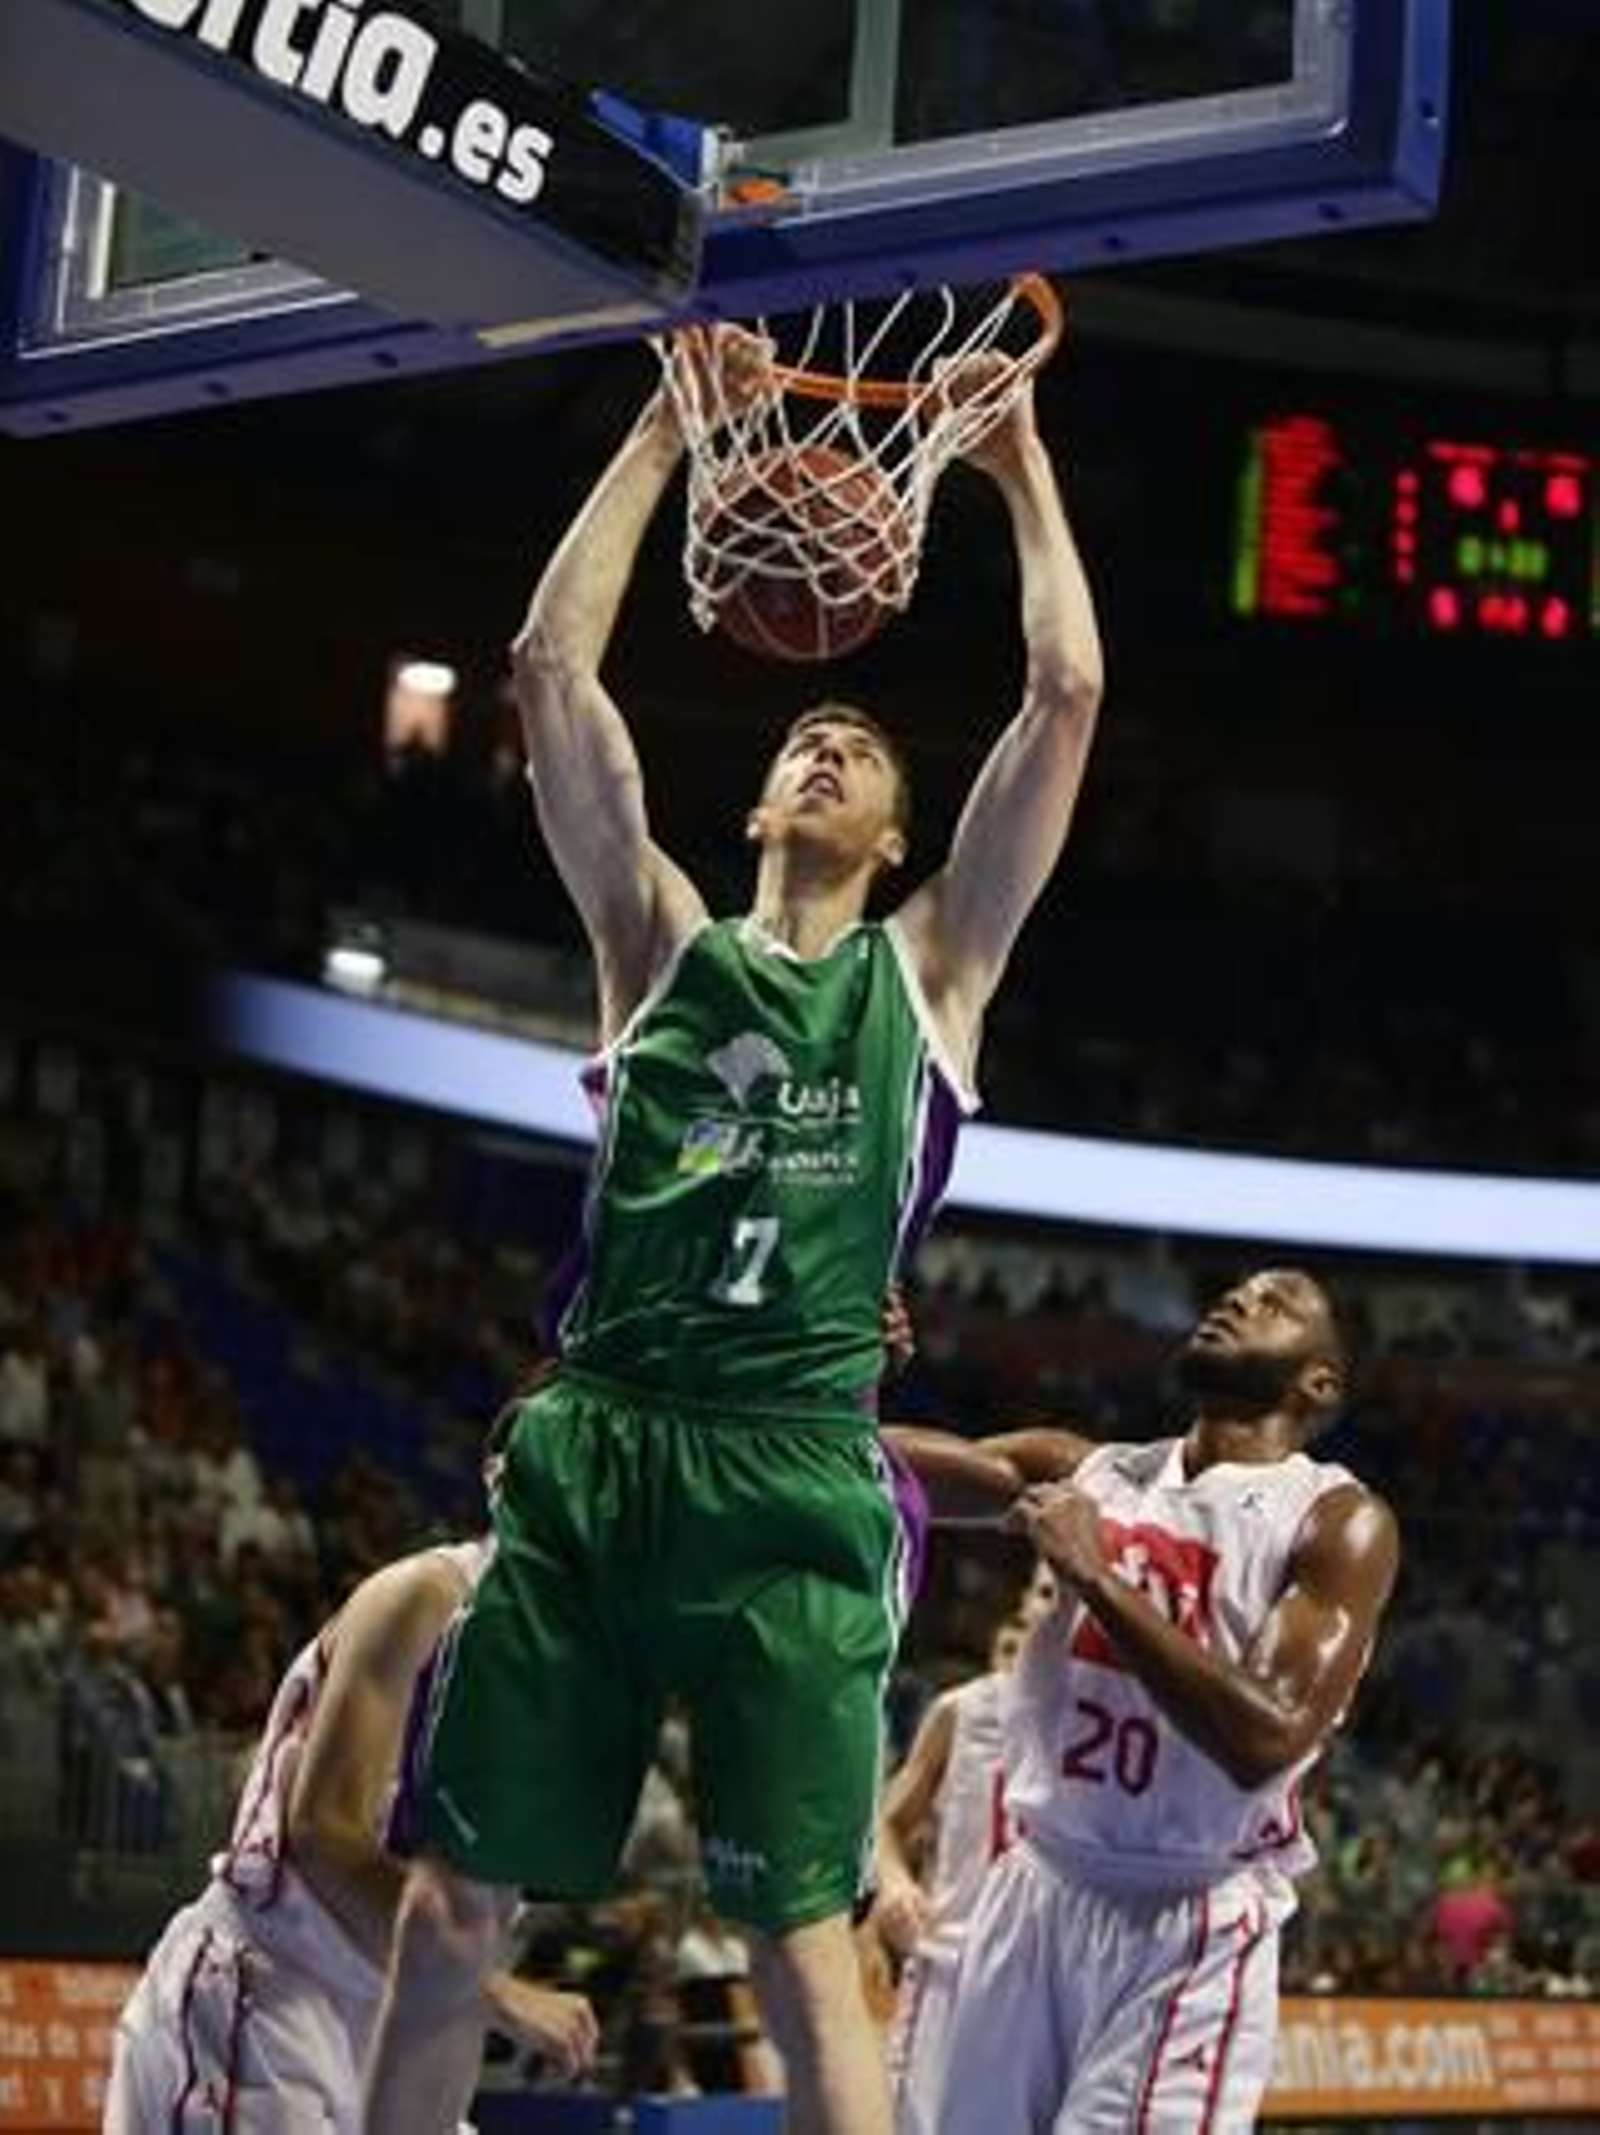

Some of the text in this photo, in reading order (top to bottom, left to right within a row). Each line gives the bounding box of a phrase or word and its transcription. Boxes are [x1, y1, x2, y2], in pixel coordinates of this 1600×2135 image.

[125, 0, 554, 204] tia.es
[727, 1218, 779, 1304] 7
[1061, 1700, 1159, 1798] 20
